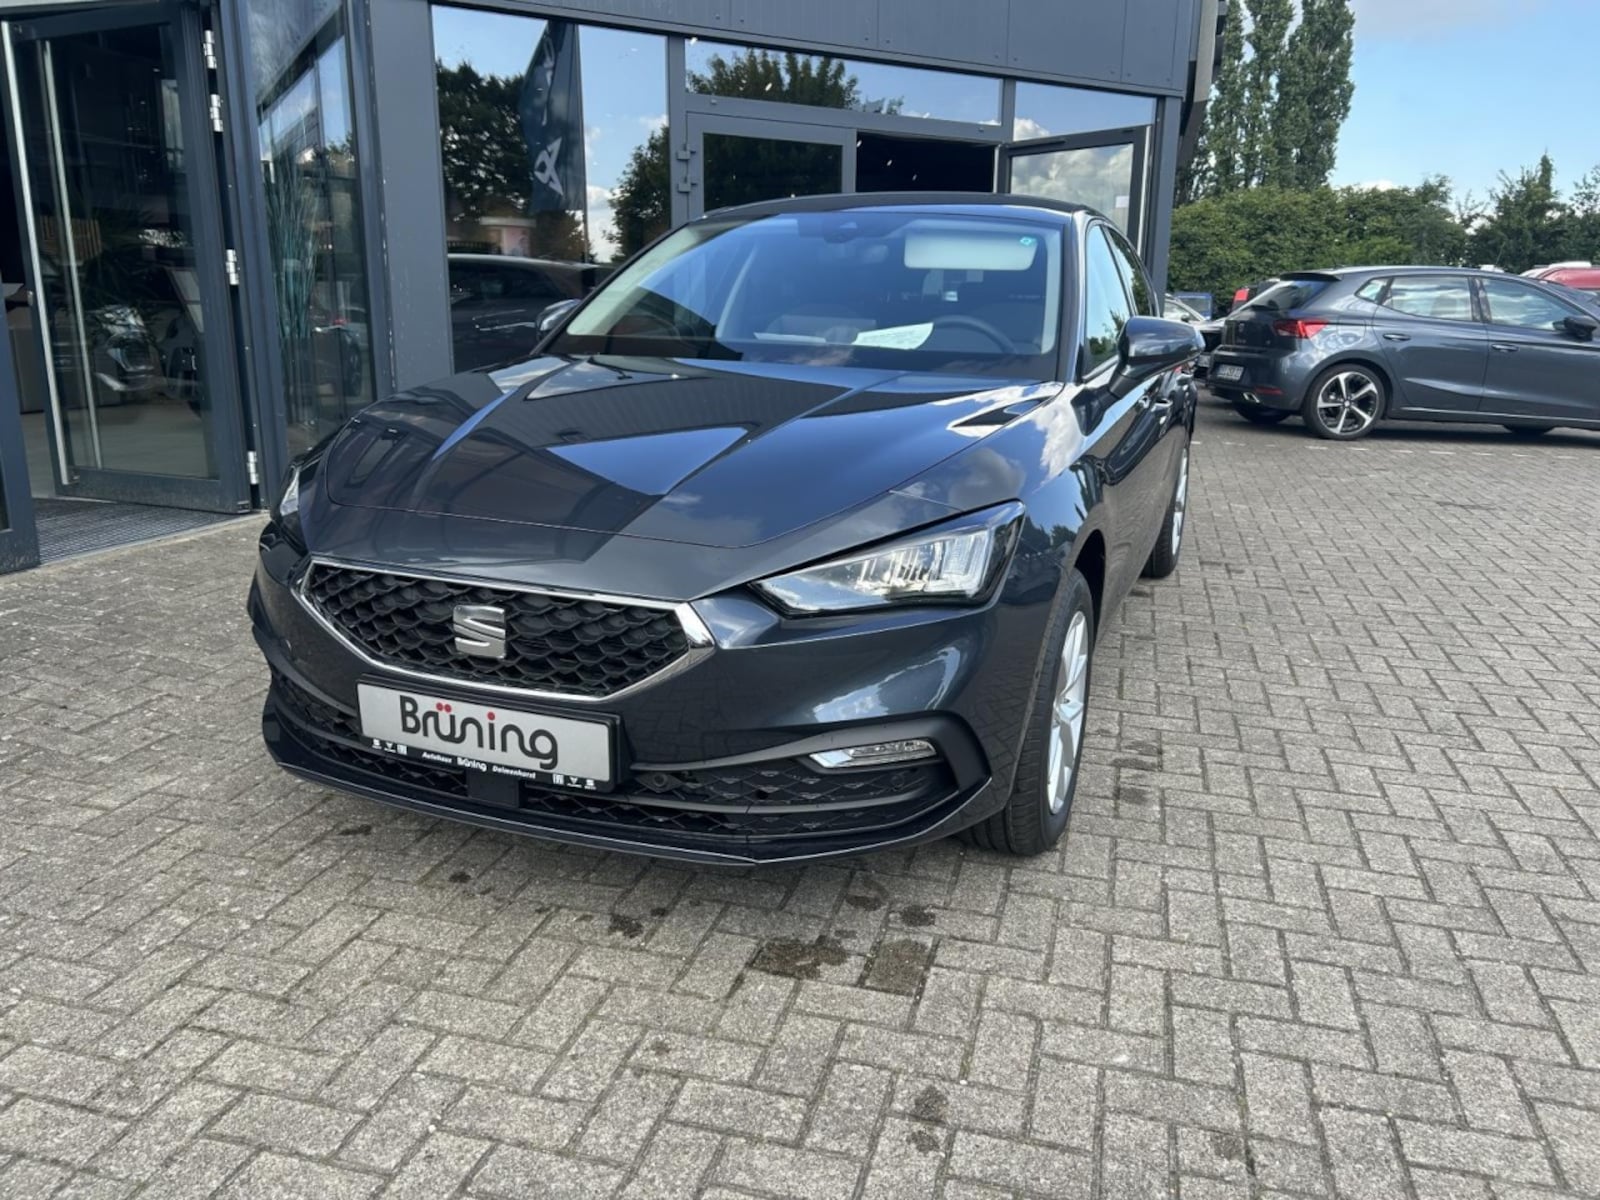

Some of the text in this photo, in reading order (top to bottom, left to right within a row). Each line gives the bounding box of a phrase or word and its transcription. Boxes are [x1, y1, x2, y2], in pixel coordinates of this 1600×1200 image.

[400, 695, 558, 770] Brüning
[422, 751, 452, 763] Autohaus
[457, 757, 487, 772] Brüning
